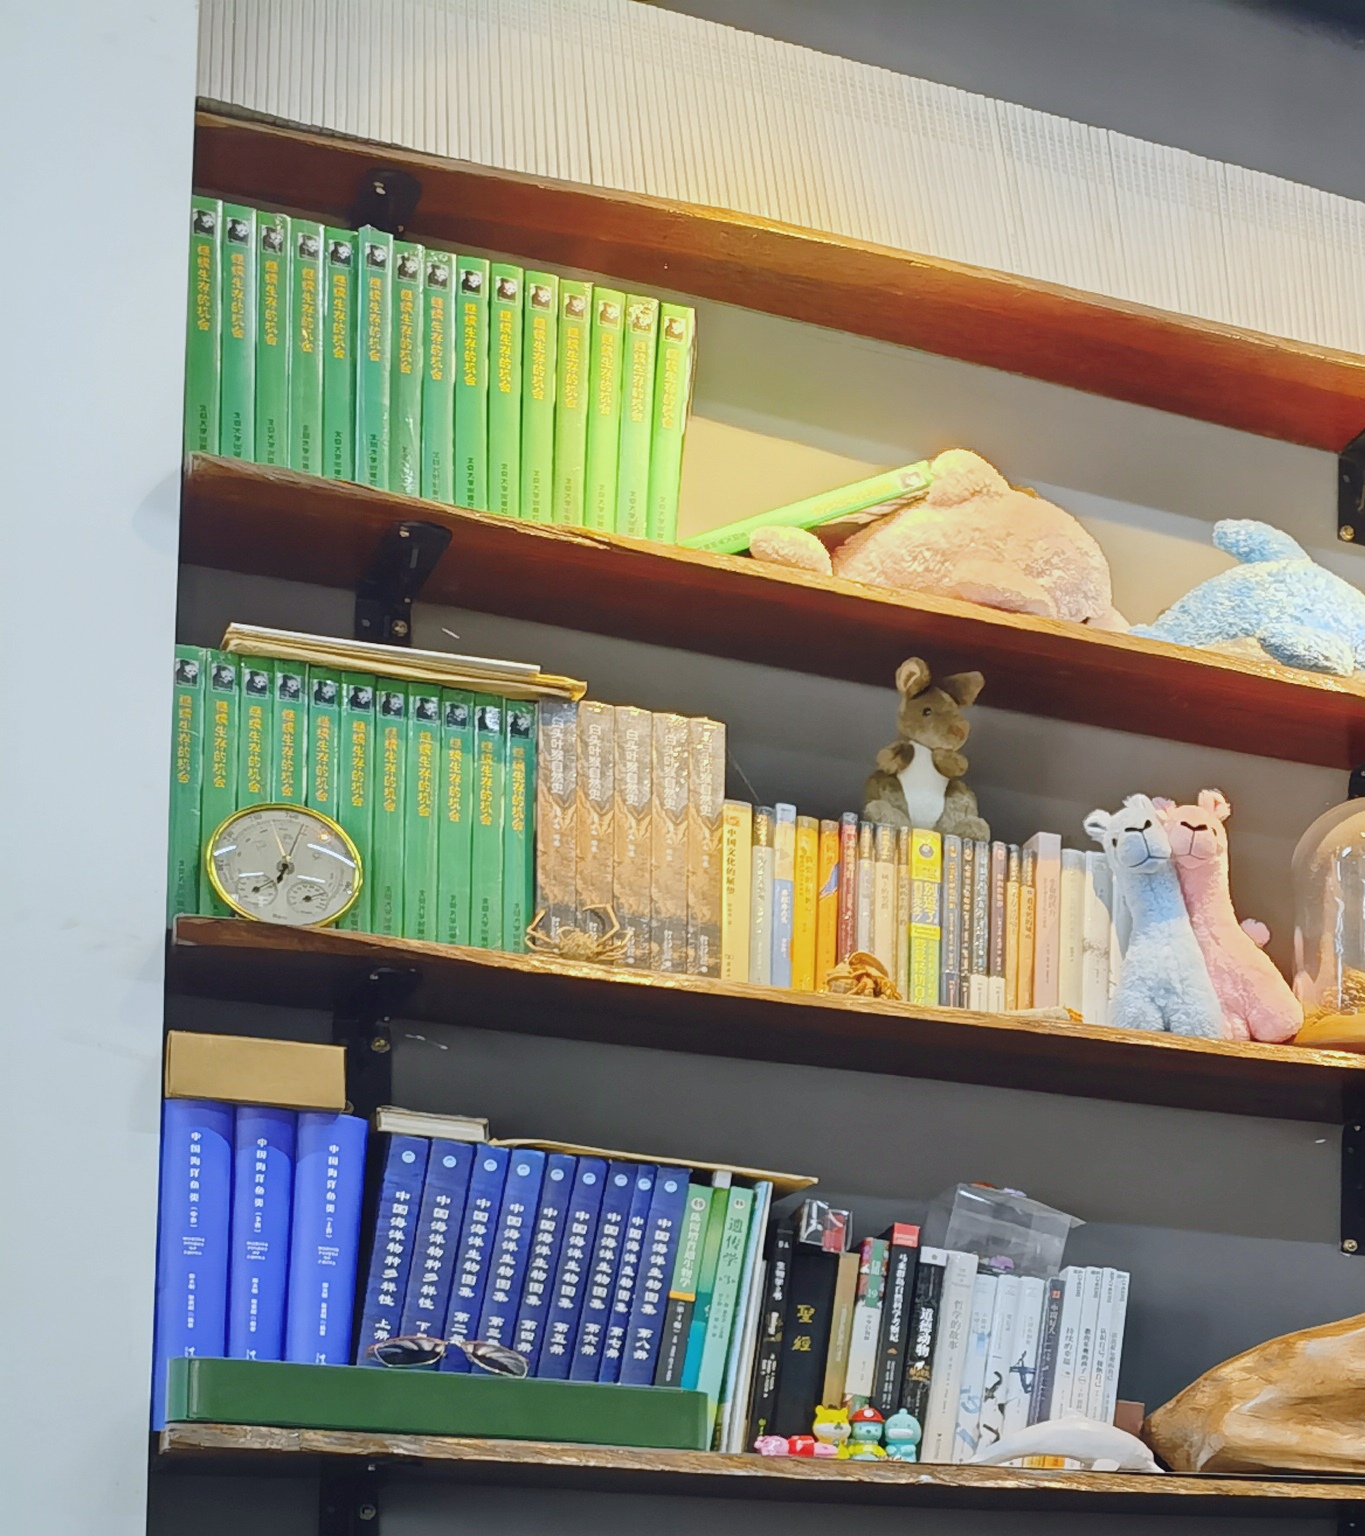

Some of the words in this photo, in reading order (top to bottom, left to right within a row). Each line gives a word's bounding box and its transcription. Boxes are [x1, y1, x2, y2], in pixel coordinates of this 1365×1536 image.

[723, 1217, 744, 1267] 遗传学
[791, 1304, 816, 1352] 聖經
[915, 1307, 935, 1358] 道德动物
